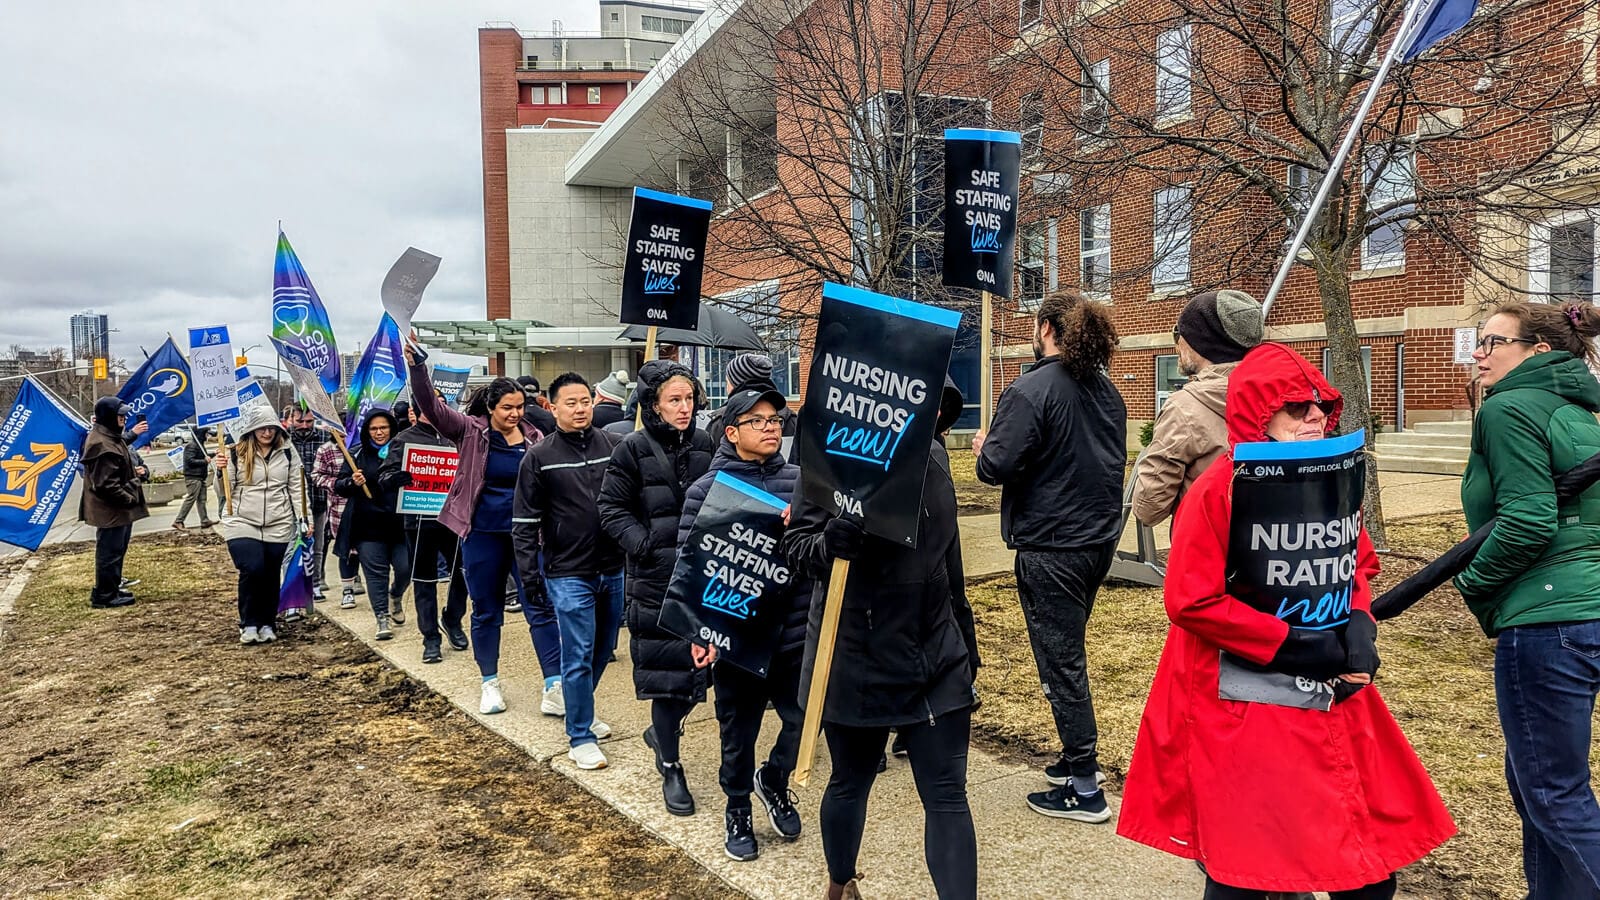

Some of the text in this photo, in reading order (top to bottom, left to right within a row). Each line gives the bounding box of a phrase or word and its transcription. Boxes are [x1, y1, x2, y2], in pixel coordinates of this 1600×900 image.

[971, 169, 1000, 189] SAFE
[955, 189, 1011, 212] STAFFING
[965, 210, 1001, 231] SAVES
[650, 224, 680, 242] SAFE
[635, 239, 696, 261] STAFFING
[641, 258, 681, 276] SAVES
[976, 269, 996, 285] ONA
[647, 308, 668, 320] ONA
[822, 353, 927, 405] NURSING
[826, 386, 909, 433] RATIOS
[825, 413, 915, 472] now!
[409, 464, 437, 476] health
[410, 452, 459, 466] Restore ou
[1254, 466, 1285, 477] ONA
[1298, 462, 1342, 474] #FIGHTLOCAL
[833, 490, 865, 518] ONA
[728, 522, 778, 555] SAFE
[1250, 510, 1362, 550] NURSING
[699, 533, 790, 585] STAFFING
[1266, 550, 1357, 586] RATIOS
[703, 559, 765, 598] SAVES
[699, 626, 731, 651] ONA
